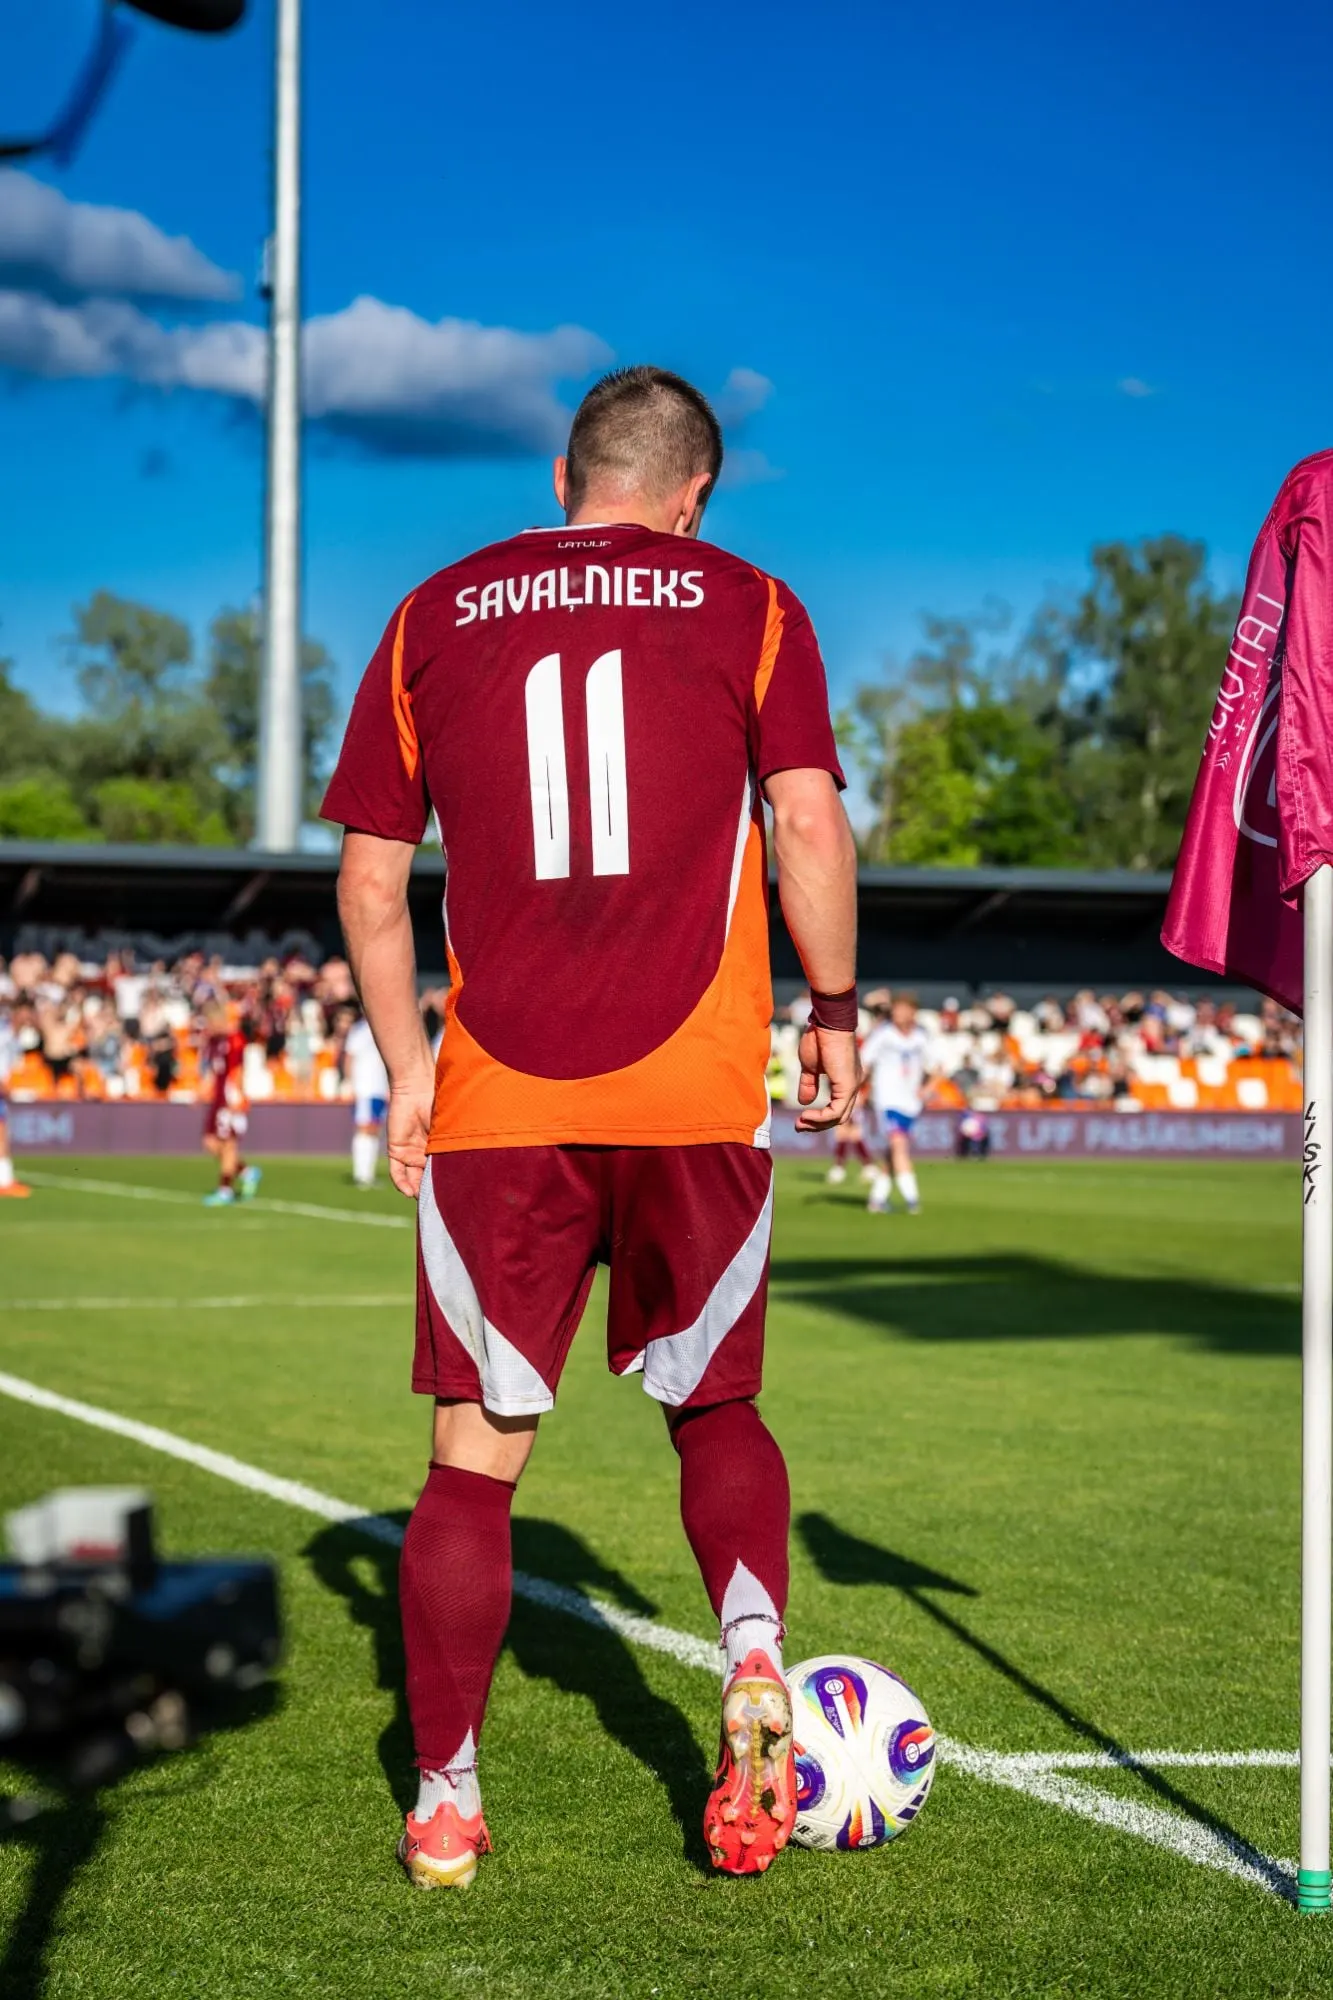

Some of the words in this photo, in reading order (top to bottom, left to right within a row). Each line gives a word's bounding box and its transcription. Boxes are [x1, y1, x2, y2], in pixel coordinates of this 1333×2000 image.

[455, 565, 705, 627] SAVAĻNIEKS
[524, 648, 630, 881] 11
[1302, 1101, 1322, 1205] LISKI
